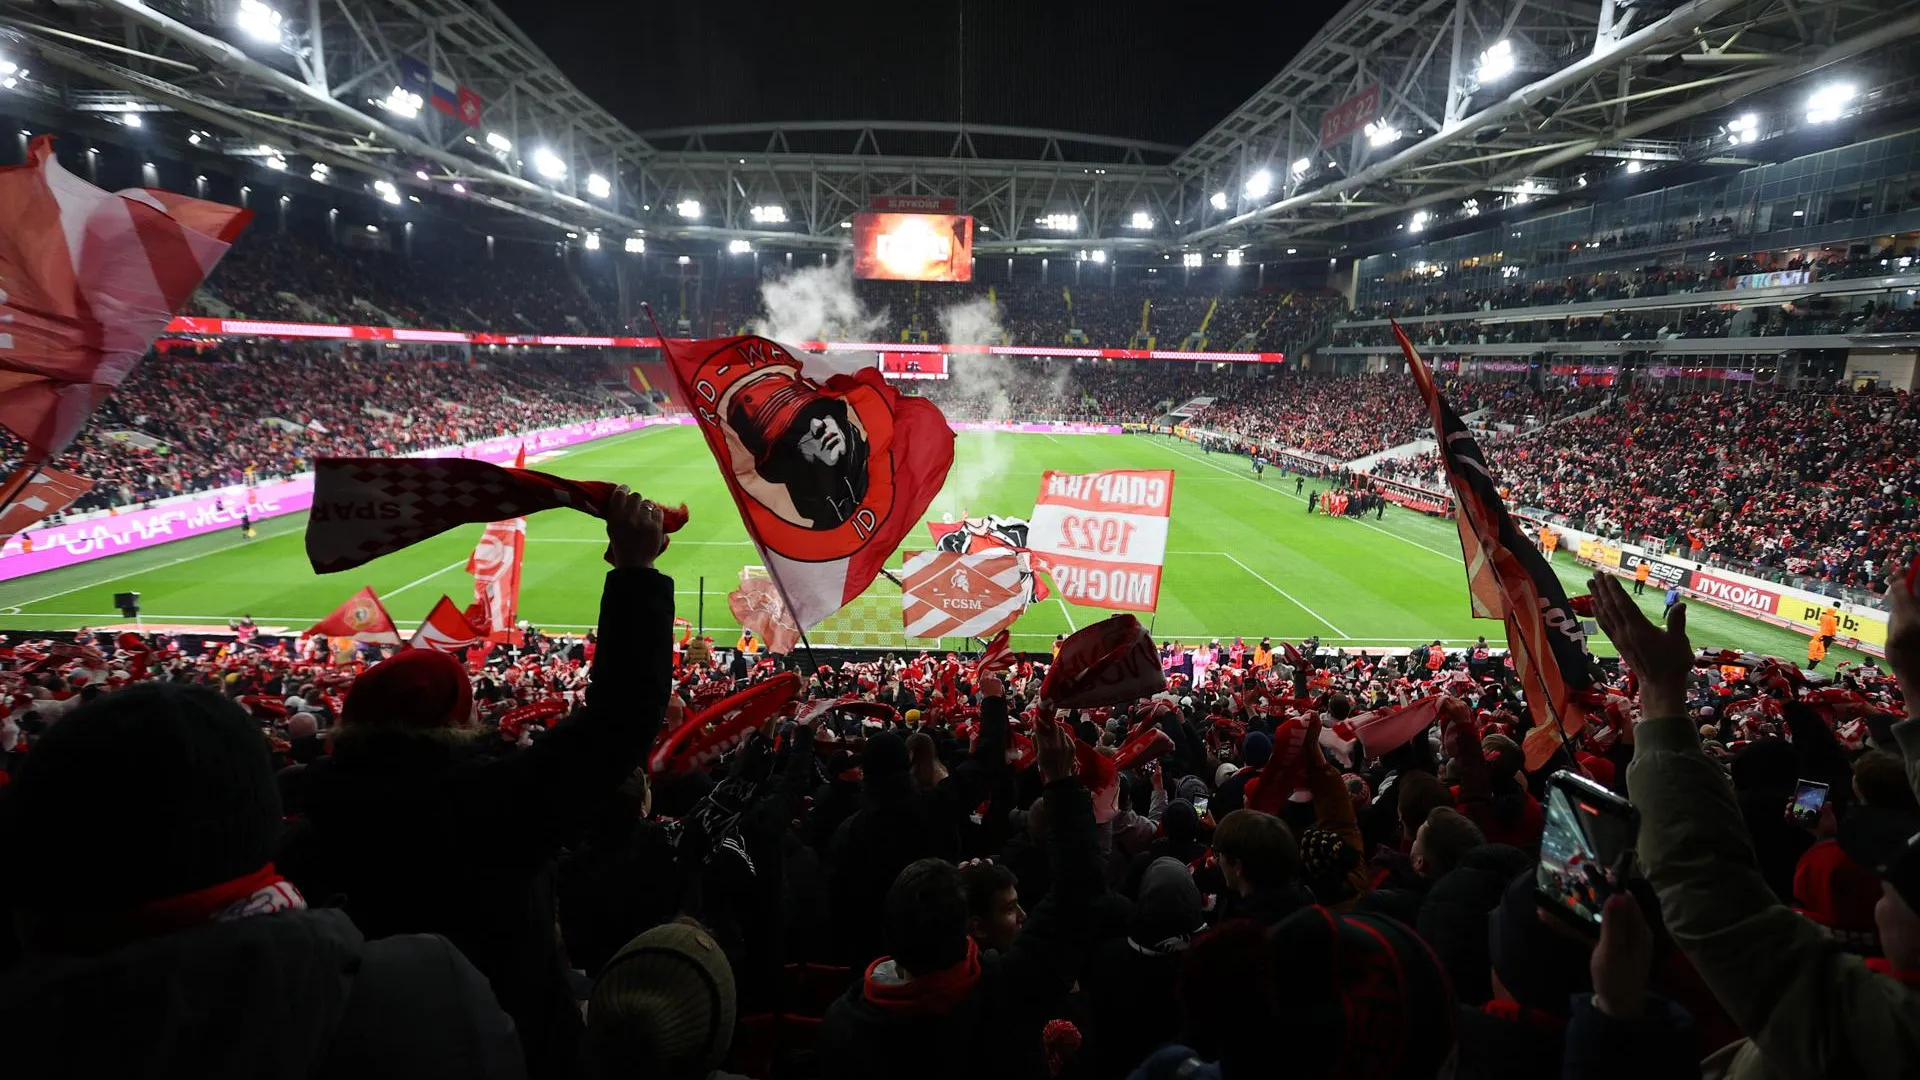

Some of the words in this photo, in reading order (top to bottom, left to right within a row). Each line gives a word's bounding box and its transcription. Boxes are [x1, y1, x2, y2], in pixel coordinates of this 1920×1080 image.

[1356, 94, 1374, 121] 22
[943, 598, 982, 610] FCSM
[1696, 577, 1772, 612] ЛУКОЙЛ
[1804, 607, 1841, 626] pln
